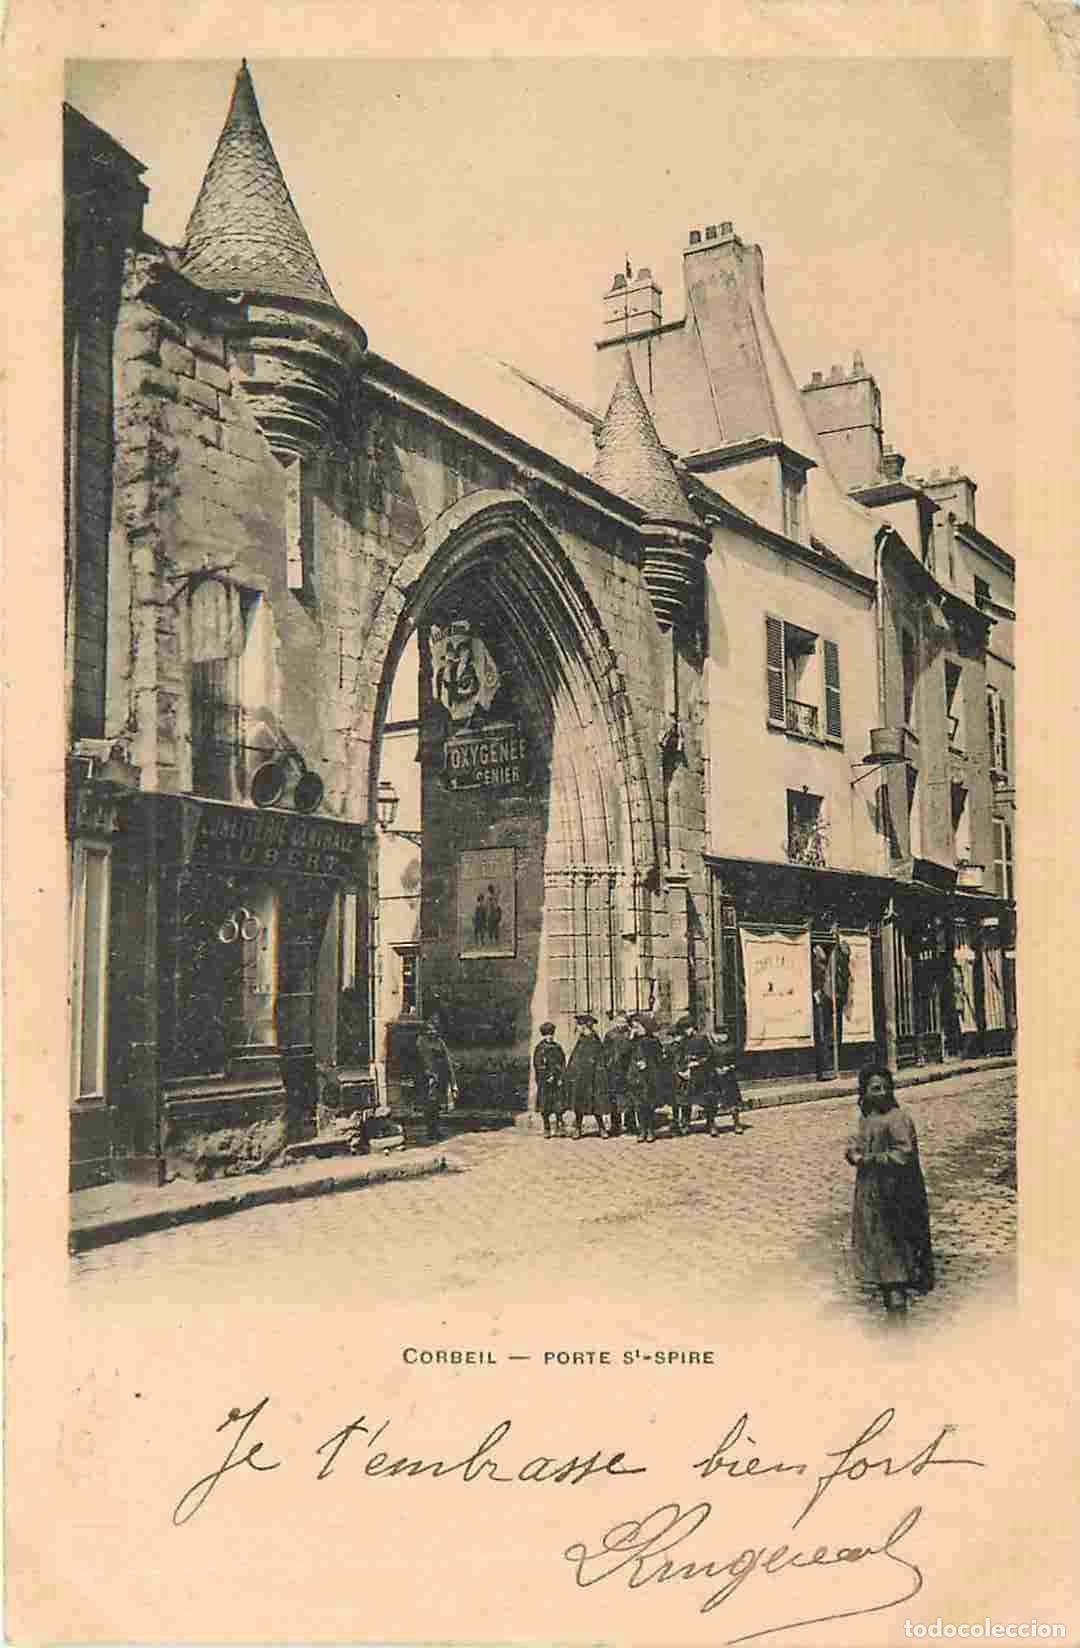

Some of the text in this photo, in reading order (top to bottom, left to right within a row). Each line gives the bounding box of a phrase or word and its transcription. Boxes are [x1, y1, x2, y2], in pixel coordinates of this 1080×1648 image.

[402, 1347, 497, 1365] CORBEIL
[543, 1351, 612, 1366] PORTE
[172, 1396, 985, 1530] Je t'embrasse bien fort
